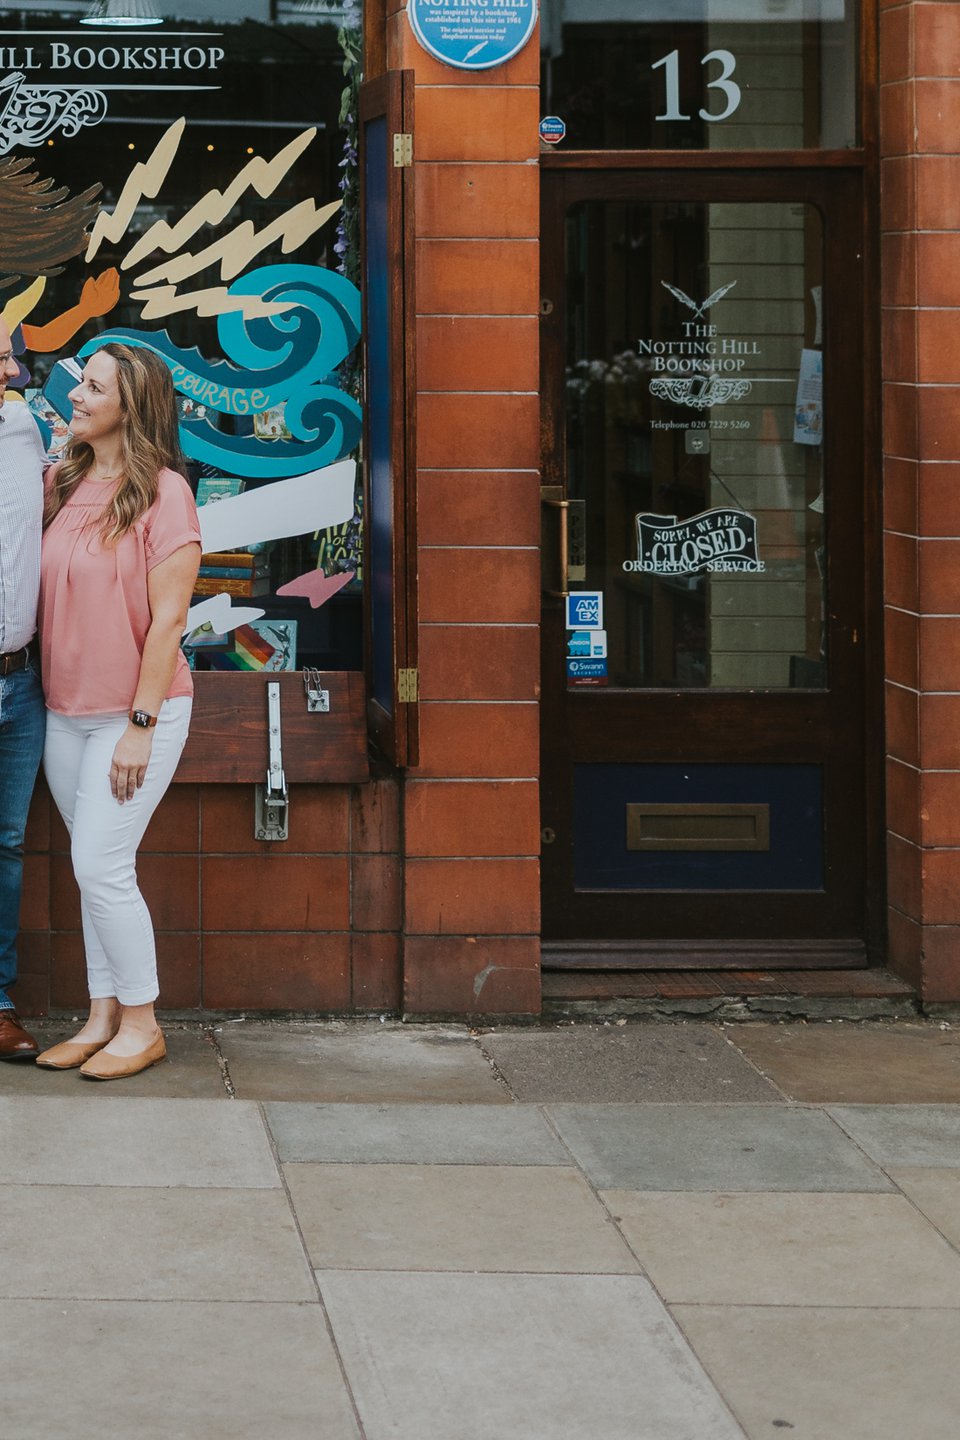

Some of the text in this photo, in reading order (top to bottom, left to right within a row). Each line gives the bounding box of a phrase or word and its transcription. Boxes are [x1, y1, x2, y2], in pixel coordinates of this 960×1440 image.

[50, 42, 225, 70] BOOKSHOP
[651, 49, 742, 122] 13
[682, 322, 717, 338] THE
[638, 339, 761, 355] NOTTING HILL
[654, 356, 746, 372] BOOKSHOP
[650, 420, 750, 430] Telephone 020 7229 5260
[696, 518, 713, 533] WE
[717, 515, 739, 527] ARE
[332, 536, 347, 546] OF
[651, 527, 746, 566] CLOSED
[622, 560, 765, 572] ORDERING SERVICE
[577, 601, 599, 610] AM
[580, 611, 598, 620] EX
[579, 662, 604, 670] Swann
